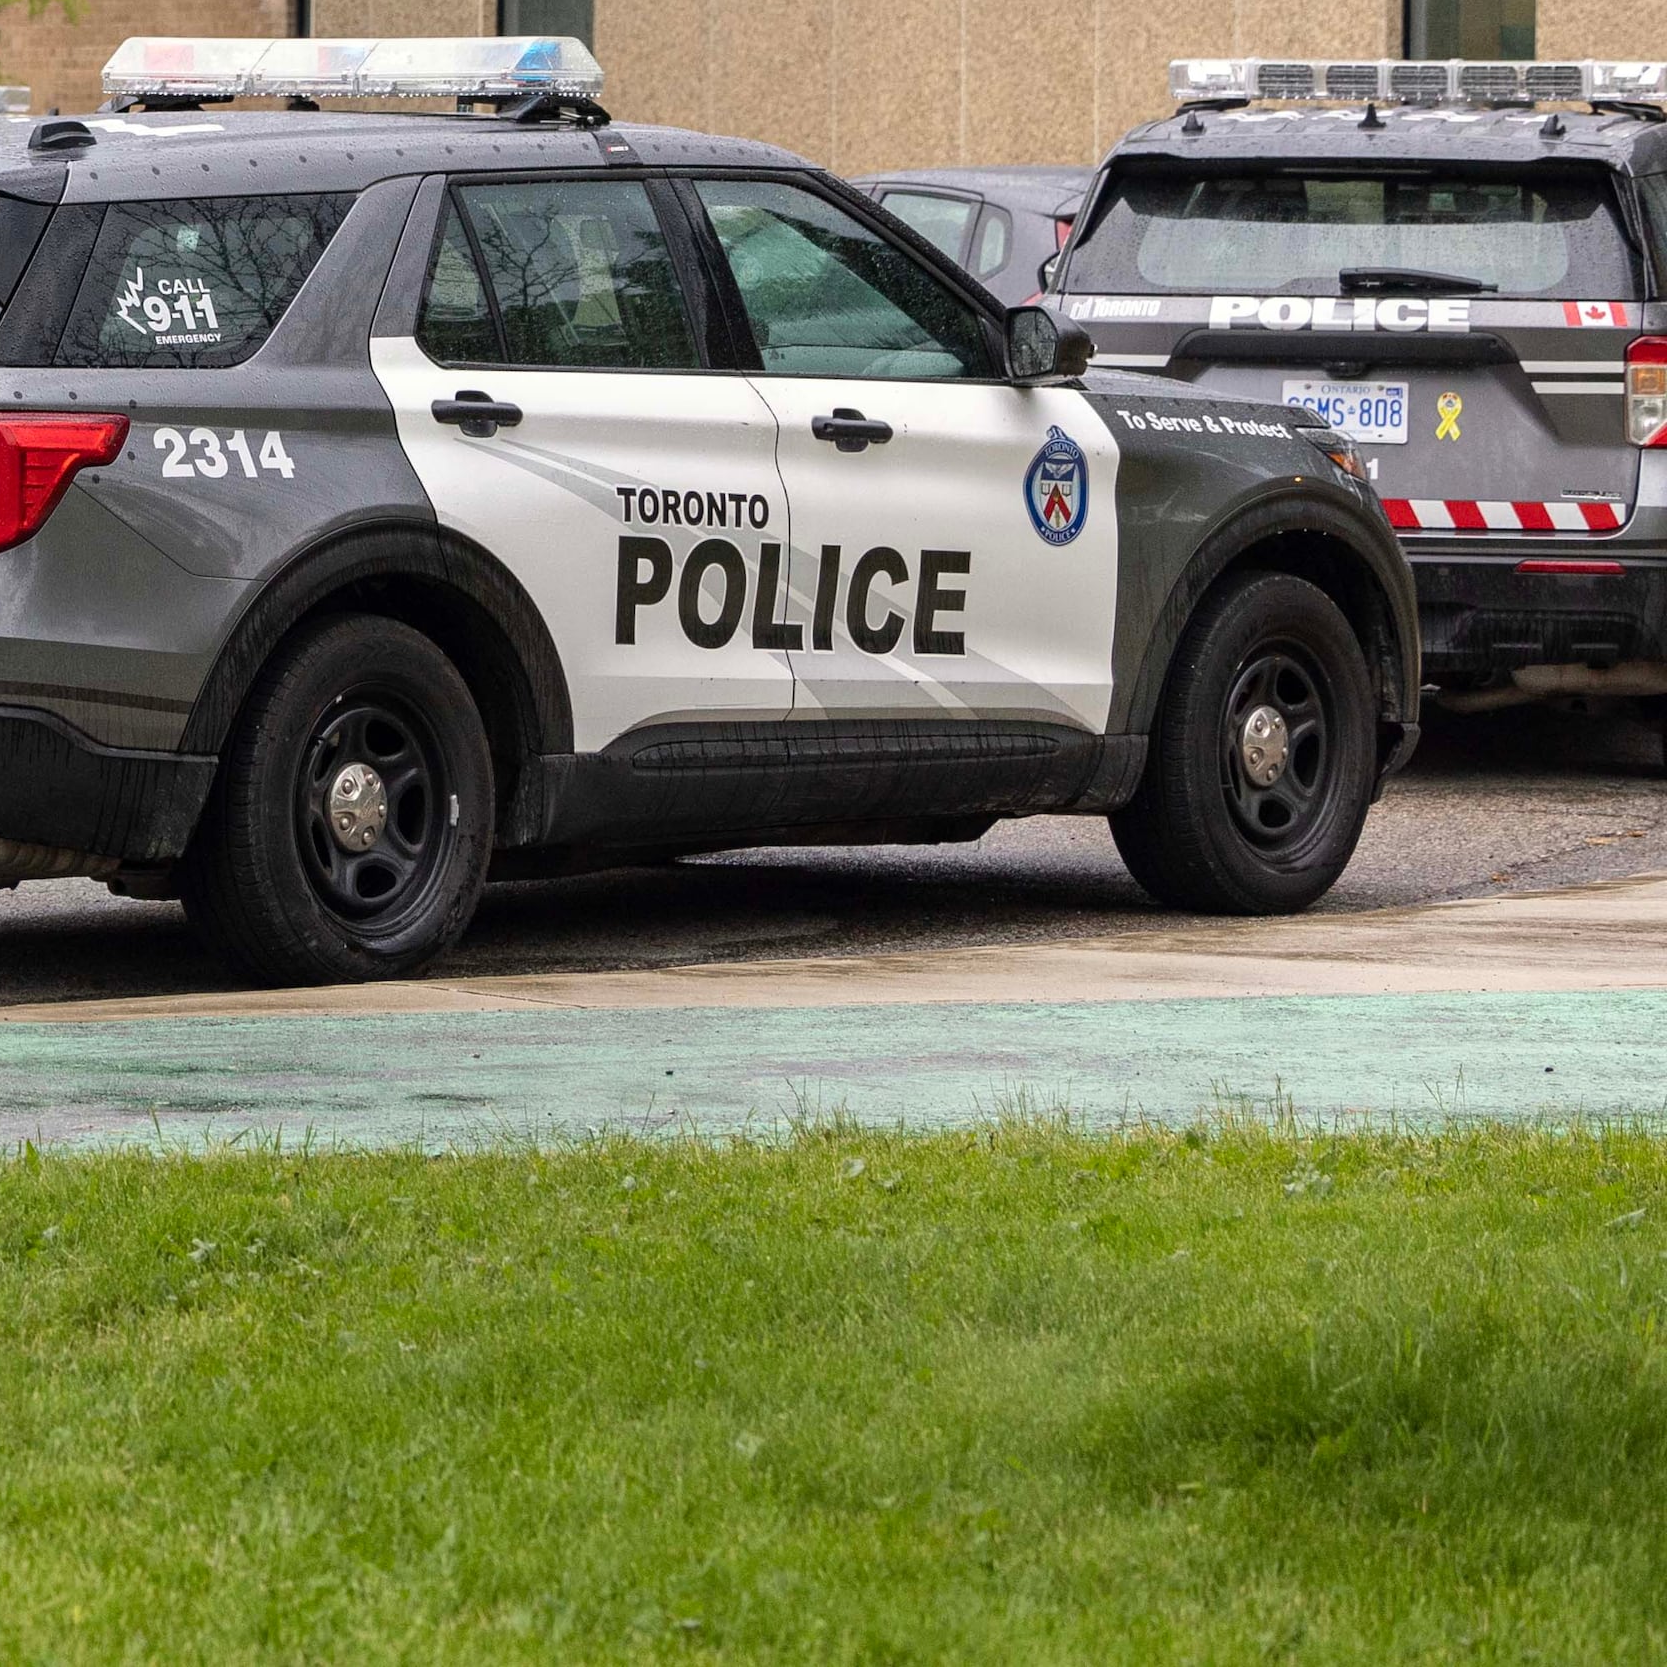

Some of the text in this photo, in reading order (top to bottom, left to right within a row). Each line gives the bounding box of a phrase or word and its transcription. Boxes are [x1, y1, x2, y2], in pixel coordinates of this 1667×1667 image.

[158, 278, 210, 295] CALL
[143, 294, 219, 332] 9-1-1
[1092, 297, 1161, 318] TORONTO
[1208, 296, 1470, 332] POLICE
[155, 333, 222, 345] EMERGENCY
[1321, 385, 1371, 394] ONTARIO
[1116, 410, 1293, 439] To Serve & Protect
[1359, 398, 1402, 427] 808
[153, 427, 296, 478] 2314
[1045, 442, 1080, 460] TORONTO
[616, 487, 769, 529] TORONTO
[1045, 531, 1071, 542] POLICE
[615, 535, 972, 655] POLICE
